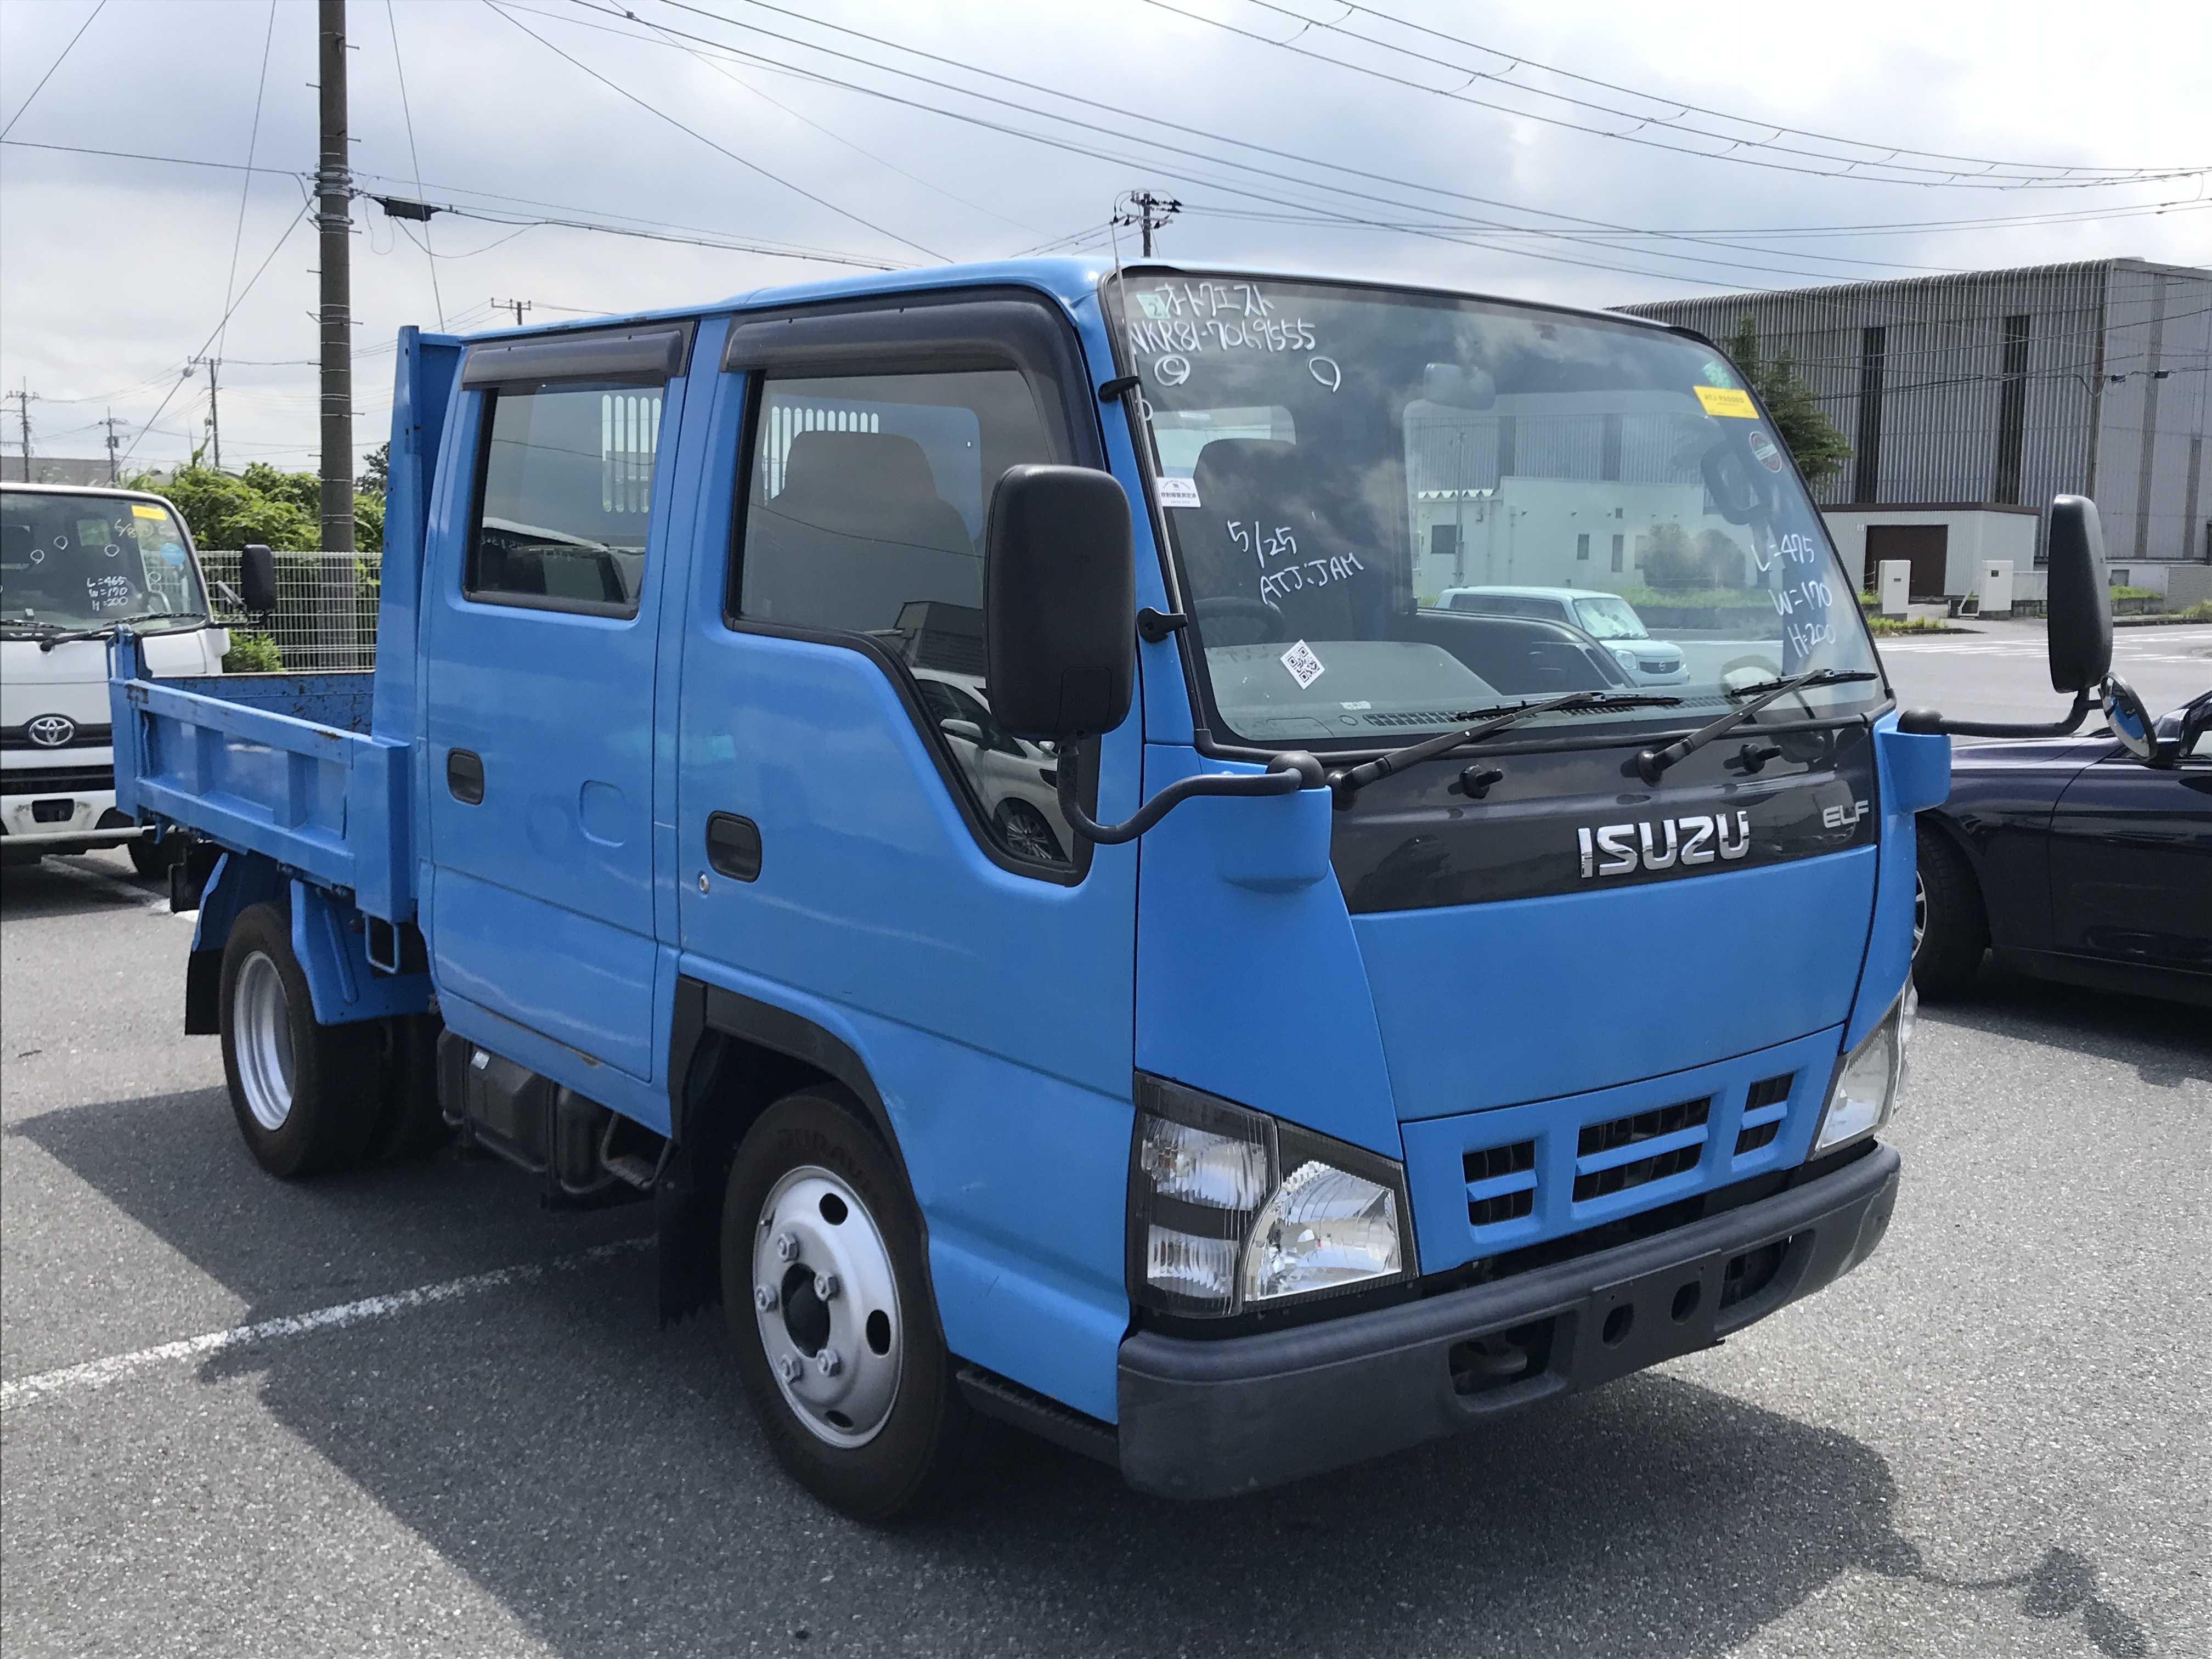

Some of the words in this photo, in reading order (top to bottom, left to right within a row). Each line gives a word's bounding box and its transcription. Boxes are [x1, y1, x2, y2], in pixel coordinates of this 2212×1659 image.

[1227, 519, 1297, 569] 5/25
[1822, 800, 1869, 828] ELF
[1577, 810, 1750, 878] ISUZU
